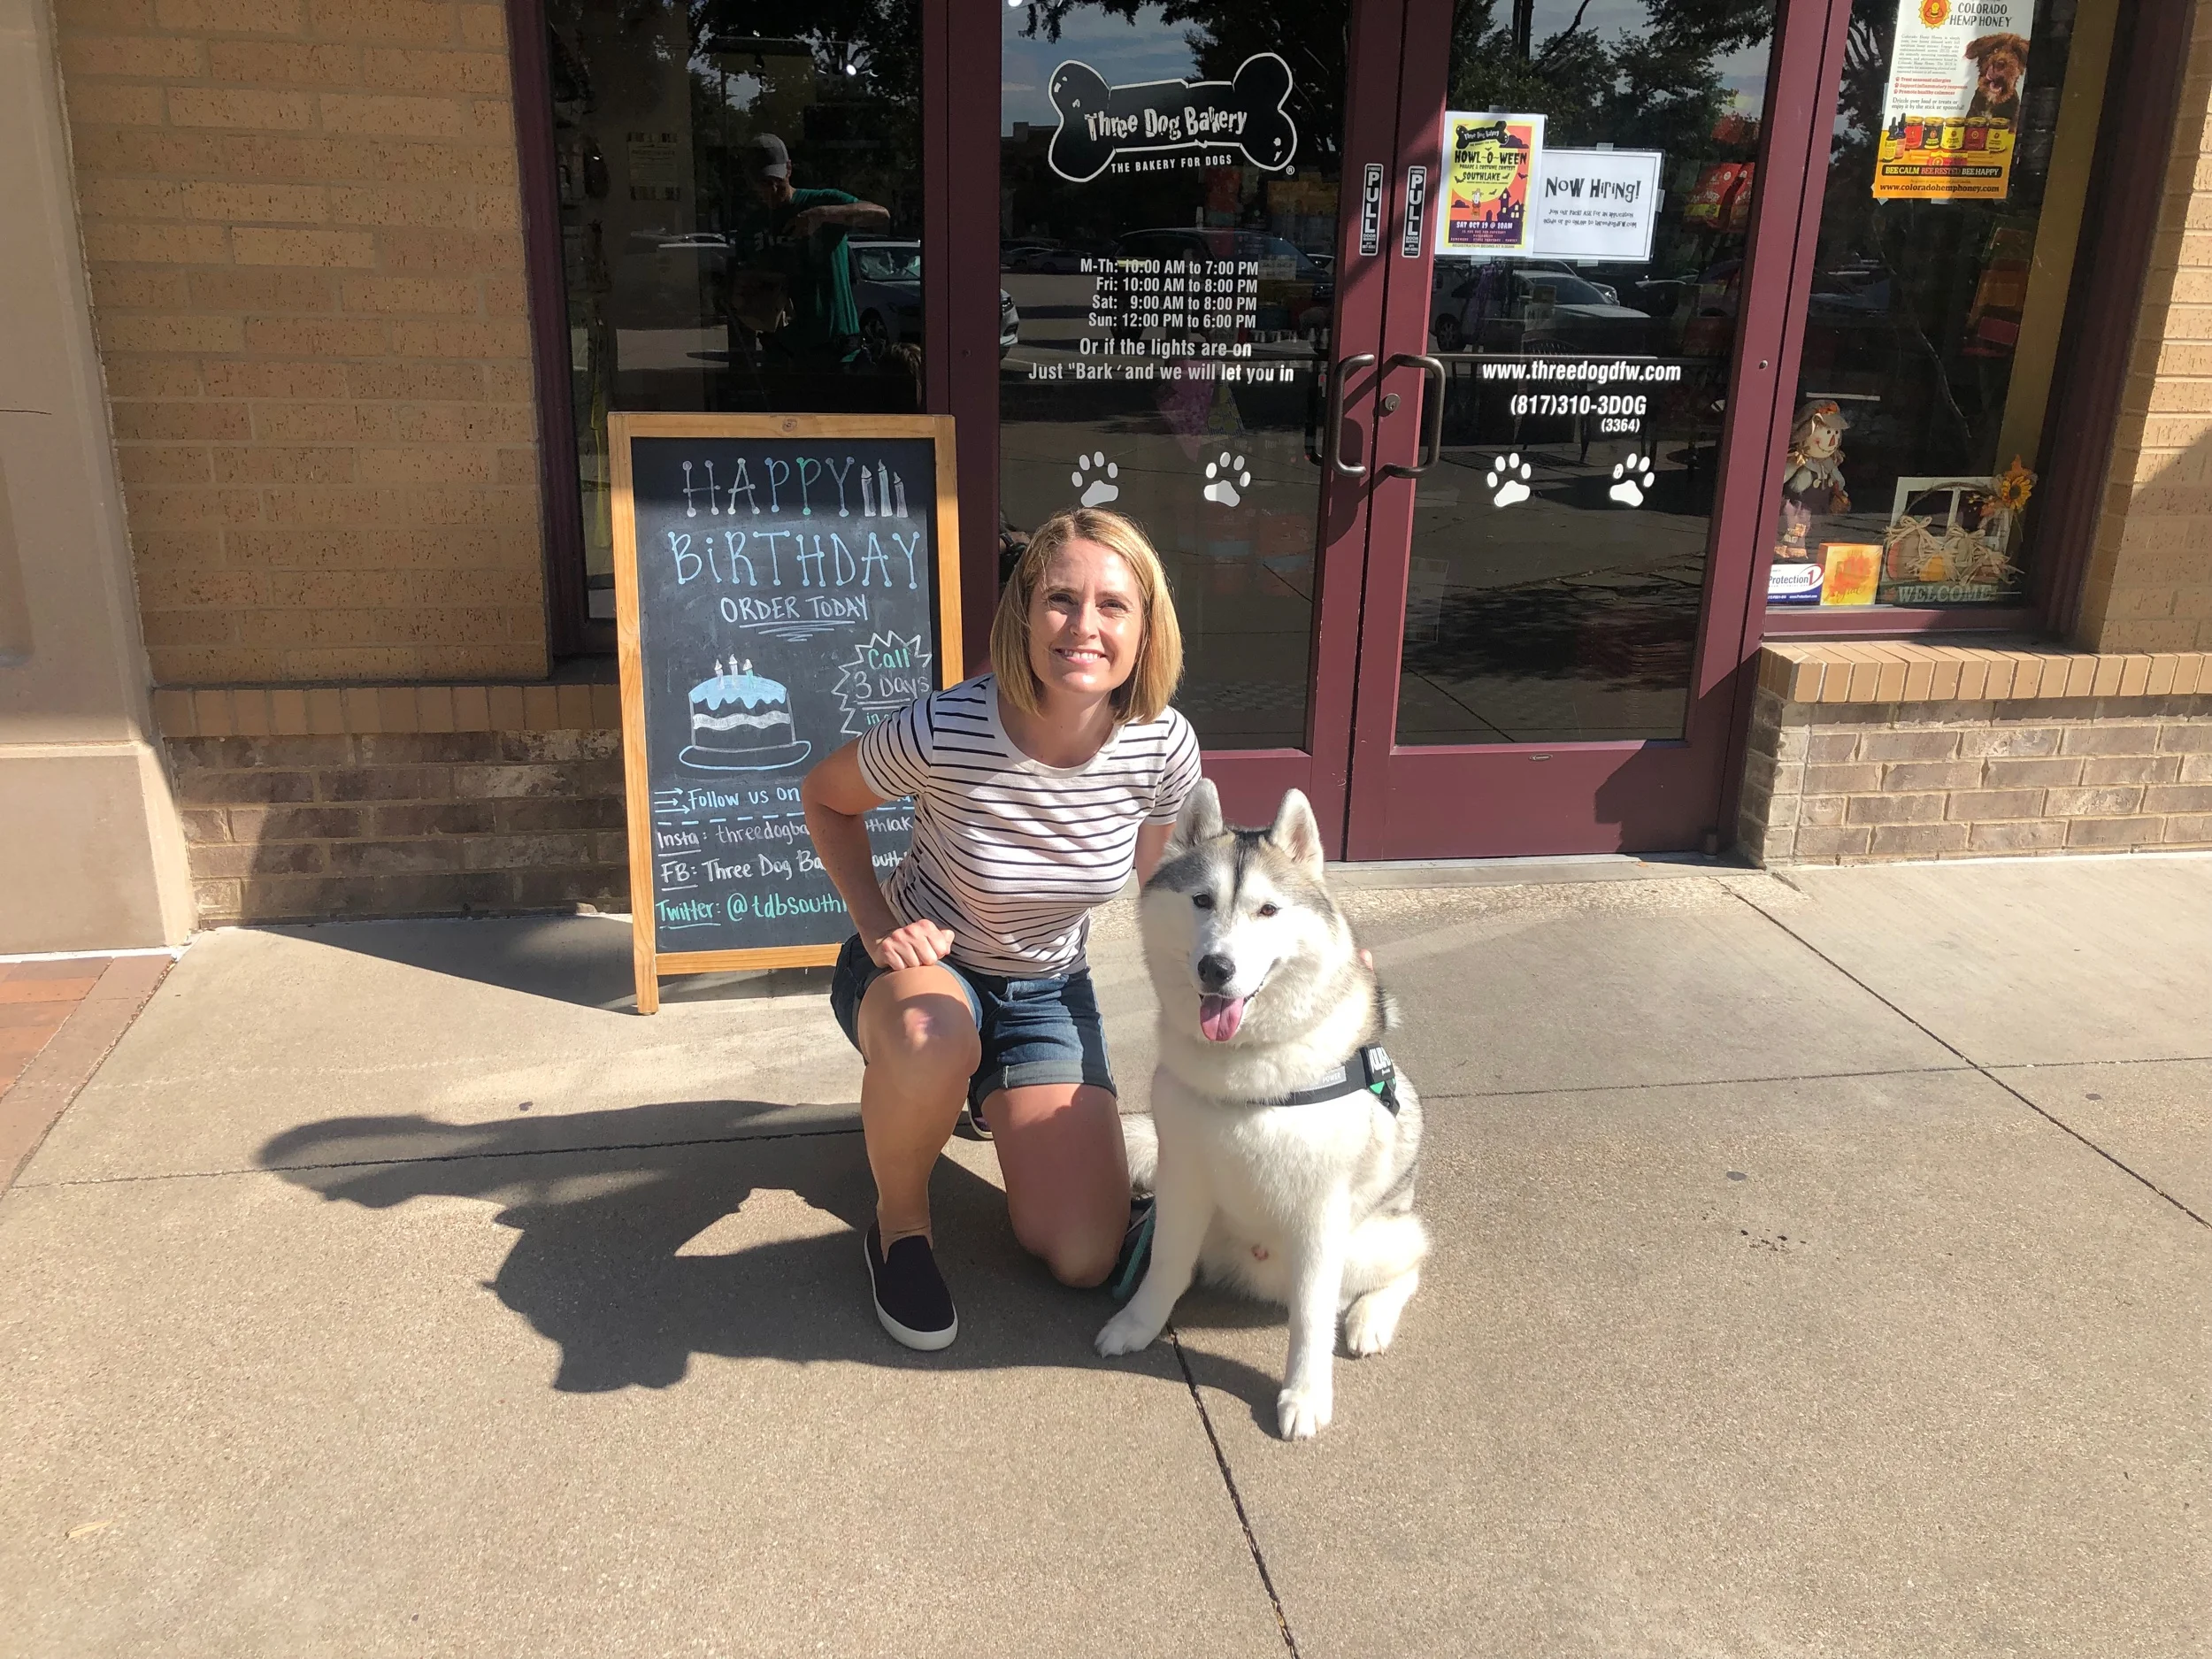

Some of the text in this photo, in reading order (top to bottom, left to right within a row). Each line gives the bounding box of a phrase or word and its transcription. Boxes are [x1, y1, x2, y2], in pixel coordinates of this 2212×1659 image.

[1957, 2, 2008, 15] COLORADO
[1949, 14, 2013, 27] HEMP HONEY
[1084, 106, 1248, 141] Three Dog Bakery
[1110, 154, 1233, 173] THE BAKERY FOR DOGS
[1463, 172, 1501, 180] SOUTHLAKE
[1879, 183, 2000, 193] www.coloradohemphoney.com
[1365, 172, 1380, 234] PULL
[1407, 173, 1424, 236] PULL
[1080, 258, 1118, 273] M-Th:
[1125, 258, 1160, 274] 10:00
[1164, 259, 1185, 274] AM
[1188, 260, 1202, 274] to
[1205, 260, 1233, 275] 7:00
[1238, 261, 1258, 276] PM
[1096, 276, 1258, 294] Fri: 10:00 AM to 8:00 PM
[1092, 295, 1257, 311] Sat: 9:00 AM to 8:00 PM
[1088, 312, 1256, 329] Sun: 12:00 PM to 6:00 PM
[1079, 337, 1252, 360] Or if the lights are on
[1028, 362, 1063, 380] Just
[1125, 363, 1154, 380] and
[1160, 367, 1182, 380] we
[1188, 363, 1216, 380] will
[1221, 364, 1241, 381] let
[1247, 367, 1274, 384] you
[1279, 365, 1294, 381] in
[1482, 360, 1681, 384] www.threedogdfw.com
[1510, 395, 1647, 416] (817)310-3DOG
[1601, 418, 1640, 433] (3364)
[682, 457, 856, 518] HAPPY
[1898, 584, 1992, 603] WELCOME
[720, 595, 801, 623] ORDER
[868, 649, 910, 670] Call
[853, 671, 930, 699] 3 Days
[866, 712, 880, 726] in
[687, 787, 801, 810] Follow us on
[715, 821, 810, 845] threedogba
[661, 860, 698, 884] FB:
[702, 858, 754, 882] Three
[757, 853, 793, 880] Dog
[796, 849, 826, 872] Ba
[655, 899, 722, 922] Twitter:
